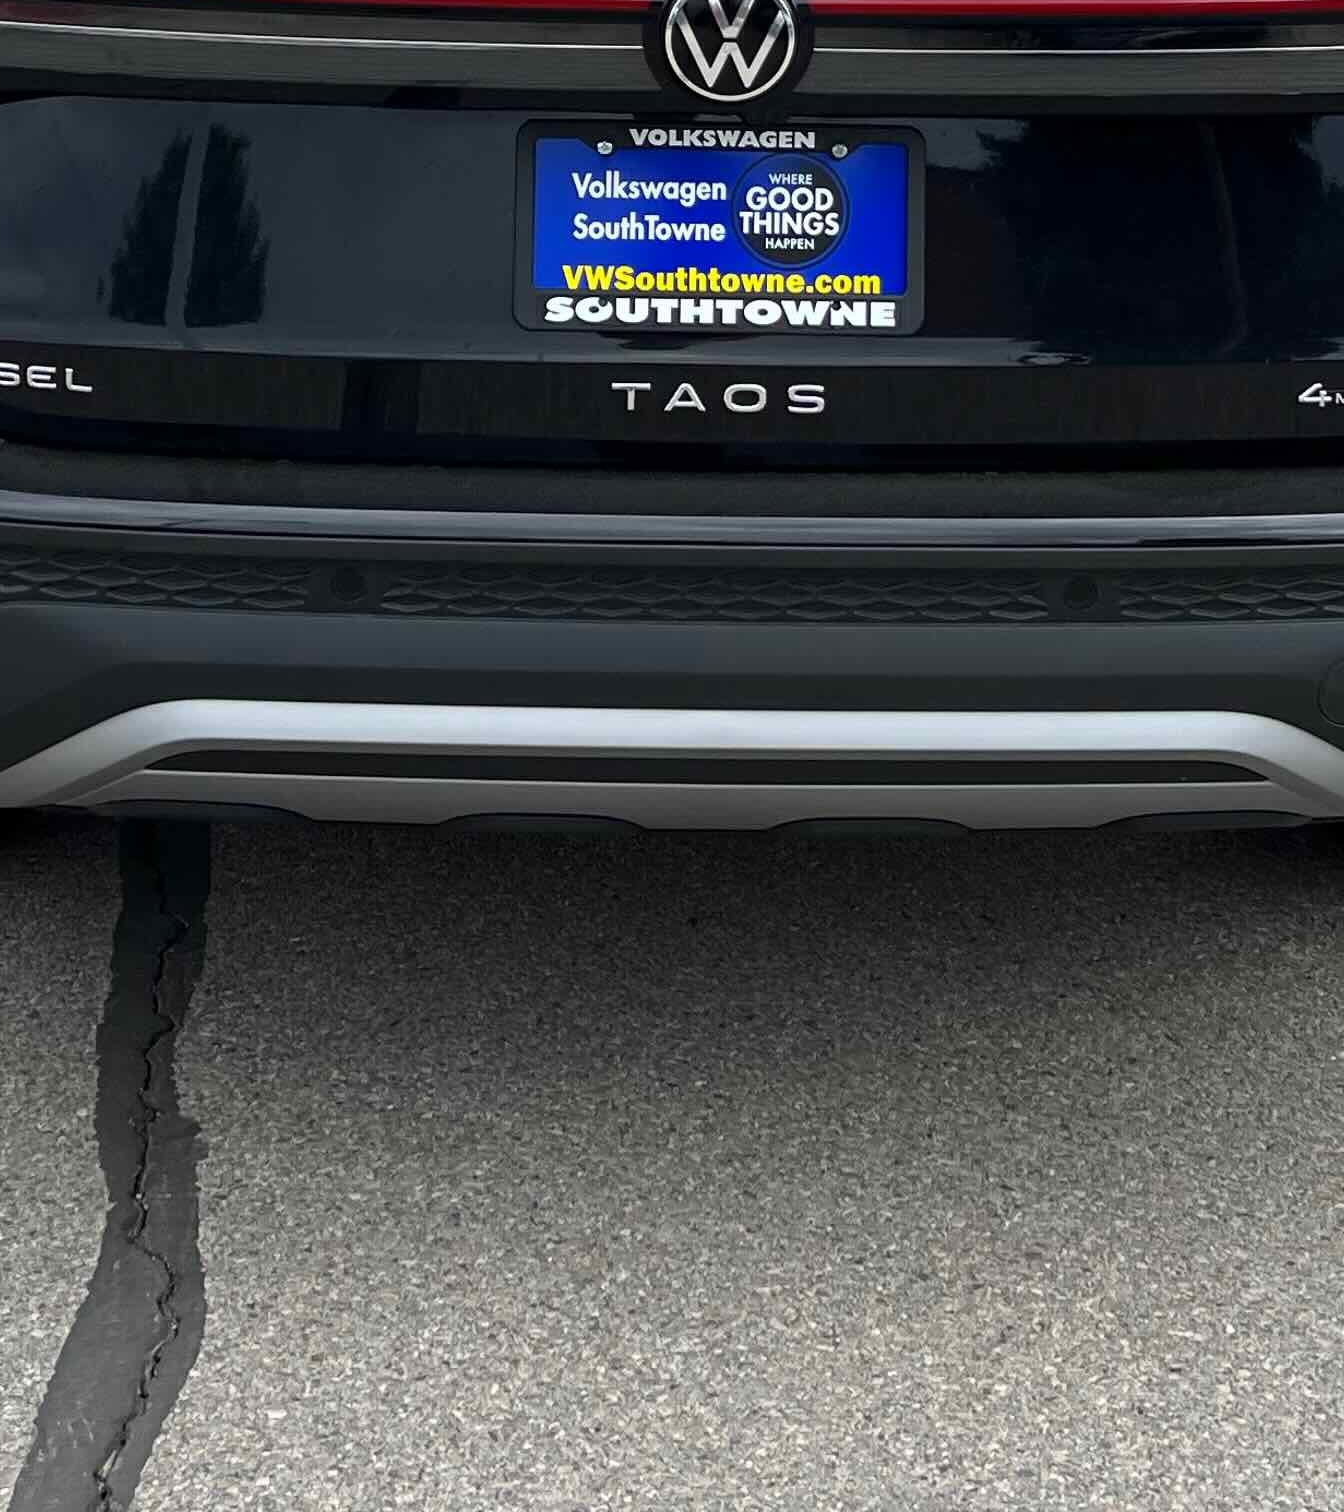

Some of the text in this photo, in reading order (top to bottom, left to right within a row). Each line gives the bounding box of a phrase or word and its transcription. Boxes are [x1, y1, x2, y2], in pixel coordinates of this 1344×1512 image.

[629, 128, 816, 150] VOLKSWAGEN
[572, 171, 727, 208] Volkswagen
[768, 173, 813, 186] WHERE
[745, 186, 834, 213] GOOD
[572, 212, 726, 242] SouthTowne
[738, 211, 840, 237] THINGS
[765, 237, 815, 251] HAPPEN
[562, 265, 881, 295] VWSouthtowne.com
[544, 296, 897, 327] SOUTHTOWNE
[611, 381, 825, 414] TAOS
